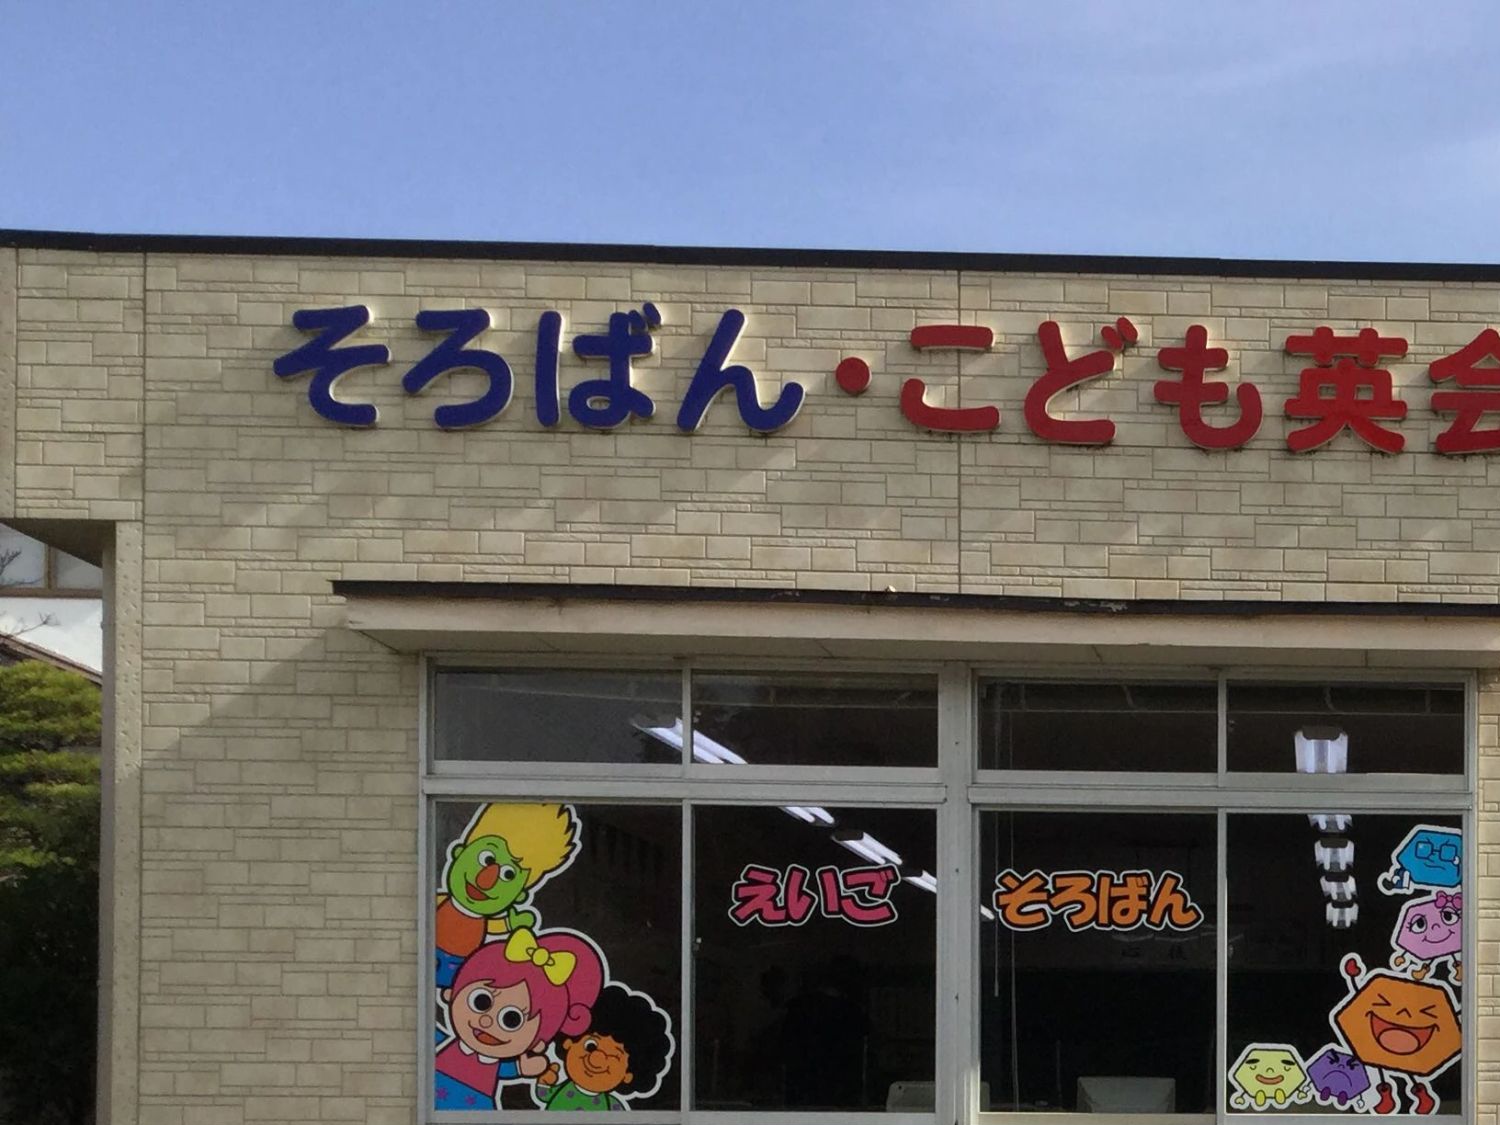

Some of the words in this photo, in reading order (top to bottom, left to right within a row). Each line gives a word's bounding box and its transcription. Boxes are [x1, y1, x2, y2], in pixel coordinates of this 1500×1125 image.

[731, 865, 900, 926] えいご
[996, 869, 1204, 930] そろばん
